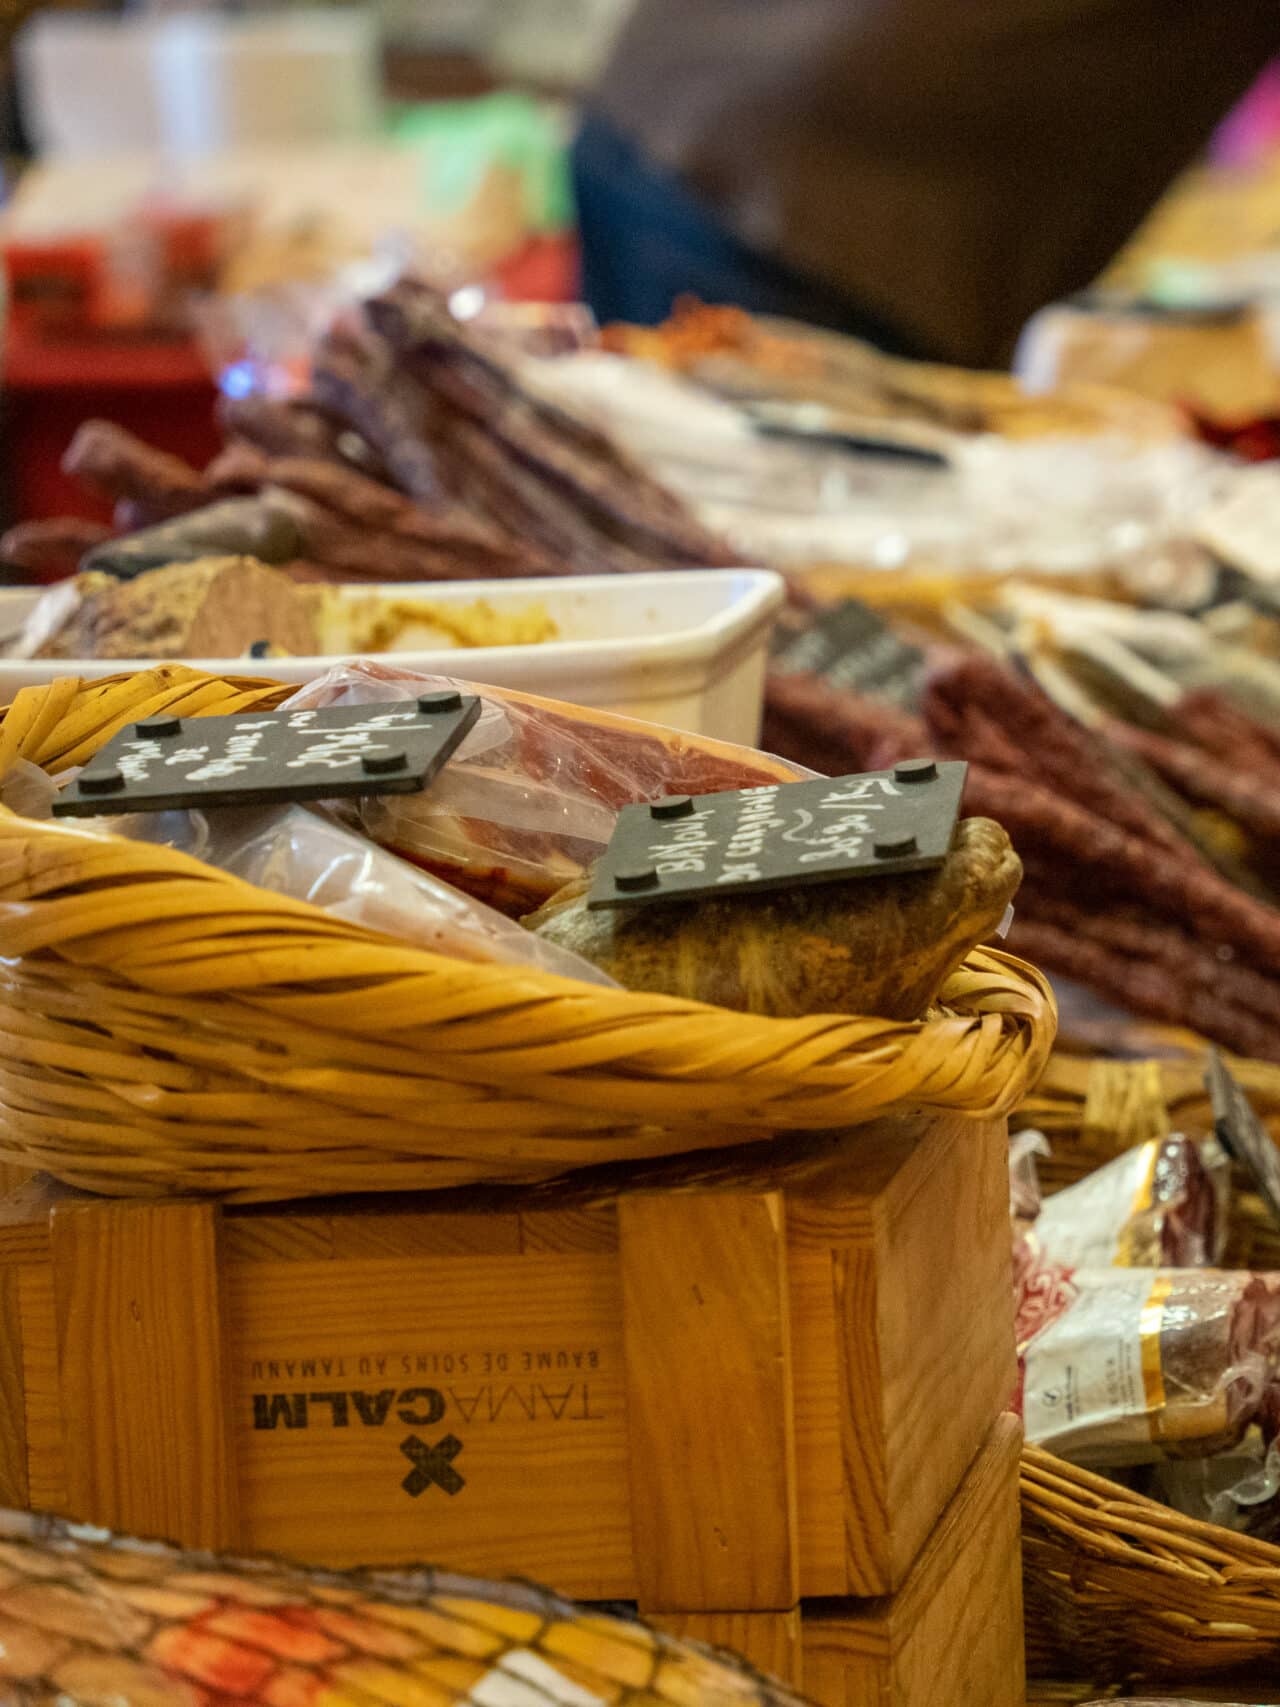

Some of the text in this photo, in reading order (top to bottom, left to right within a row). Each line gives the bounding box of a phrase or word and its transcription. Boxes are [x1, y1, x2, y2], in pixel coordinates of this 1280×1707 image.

[251, 1350, 600, 1380] BAUME DE SOINS AU TAMANU
